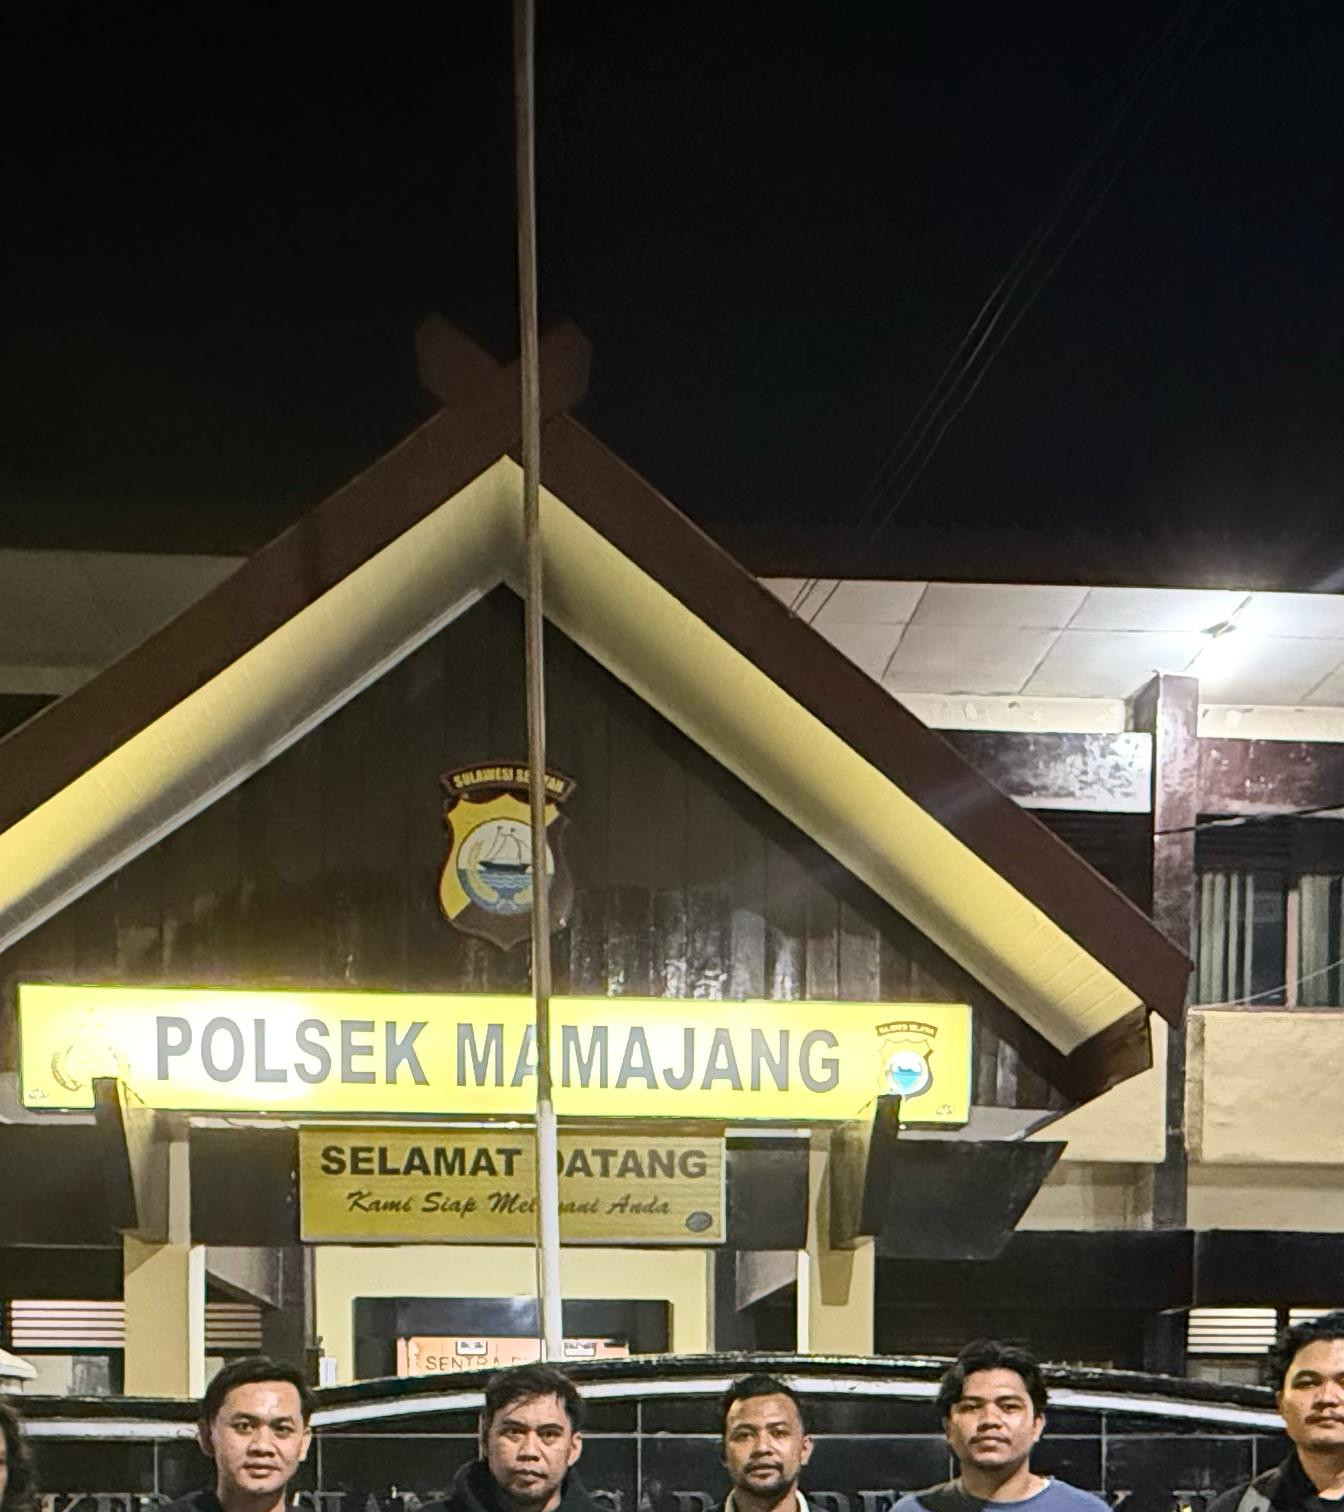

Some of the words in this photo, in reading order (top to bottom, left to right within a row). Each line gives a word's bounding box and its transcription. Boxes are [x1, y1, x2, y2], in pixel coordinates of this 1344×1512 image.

[156, 1016, 430, 1086] POLSEK
[457, 1022, 840, 1093] MAMAJANG
[321, 1145, 522, 1177] SELAMAT
[557, 1148, 707, 1179] ATANG
[347, 1190, 412, 1213] Kami
[421, 1191, 478, 1219] Siap
[605, 1194, 669, 1215] Anda
